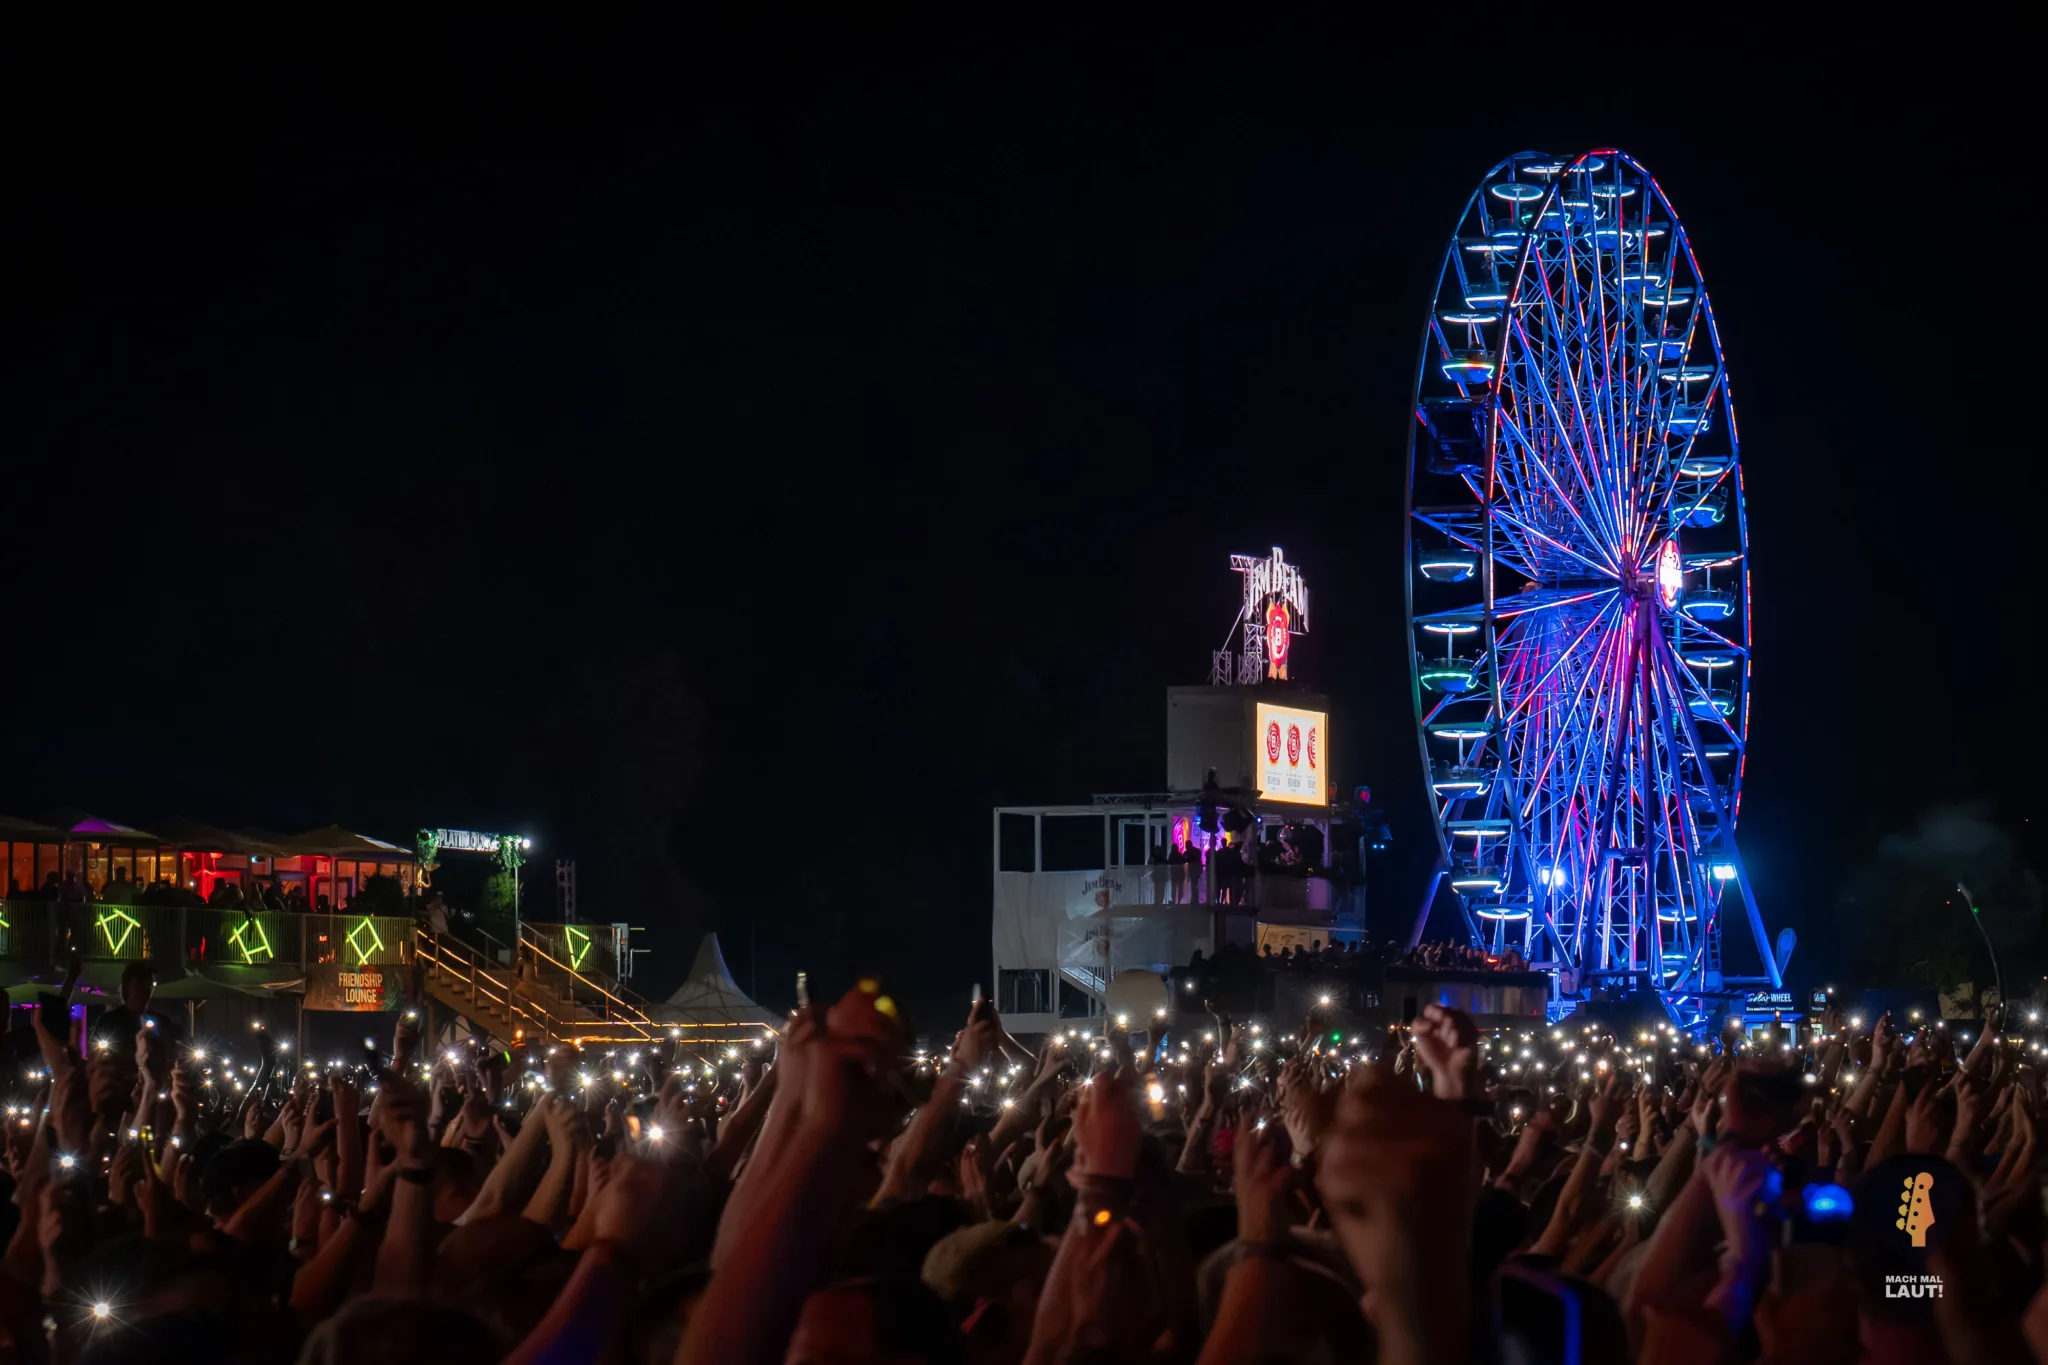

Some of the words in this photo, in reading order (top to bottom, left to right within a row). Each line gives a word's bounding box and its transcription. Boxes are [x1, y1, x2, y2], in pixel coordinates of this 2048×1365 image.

[1244, 558, 1270, 620] JIM
[1272, 547, 1309, 632] BEAM
[338, 973, 383, 987] FRIENDSHIP
[345, 989, 377, 1003] LOUNGE
[1770, 993, 1792, 1003] WHEEL
